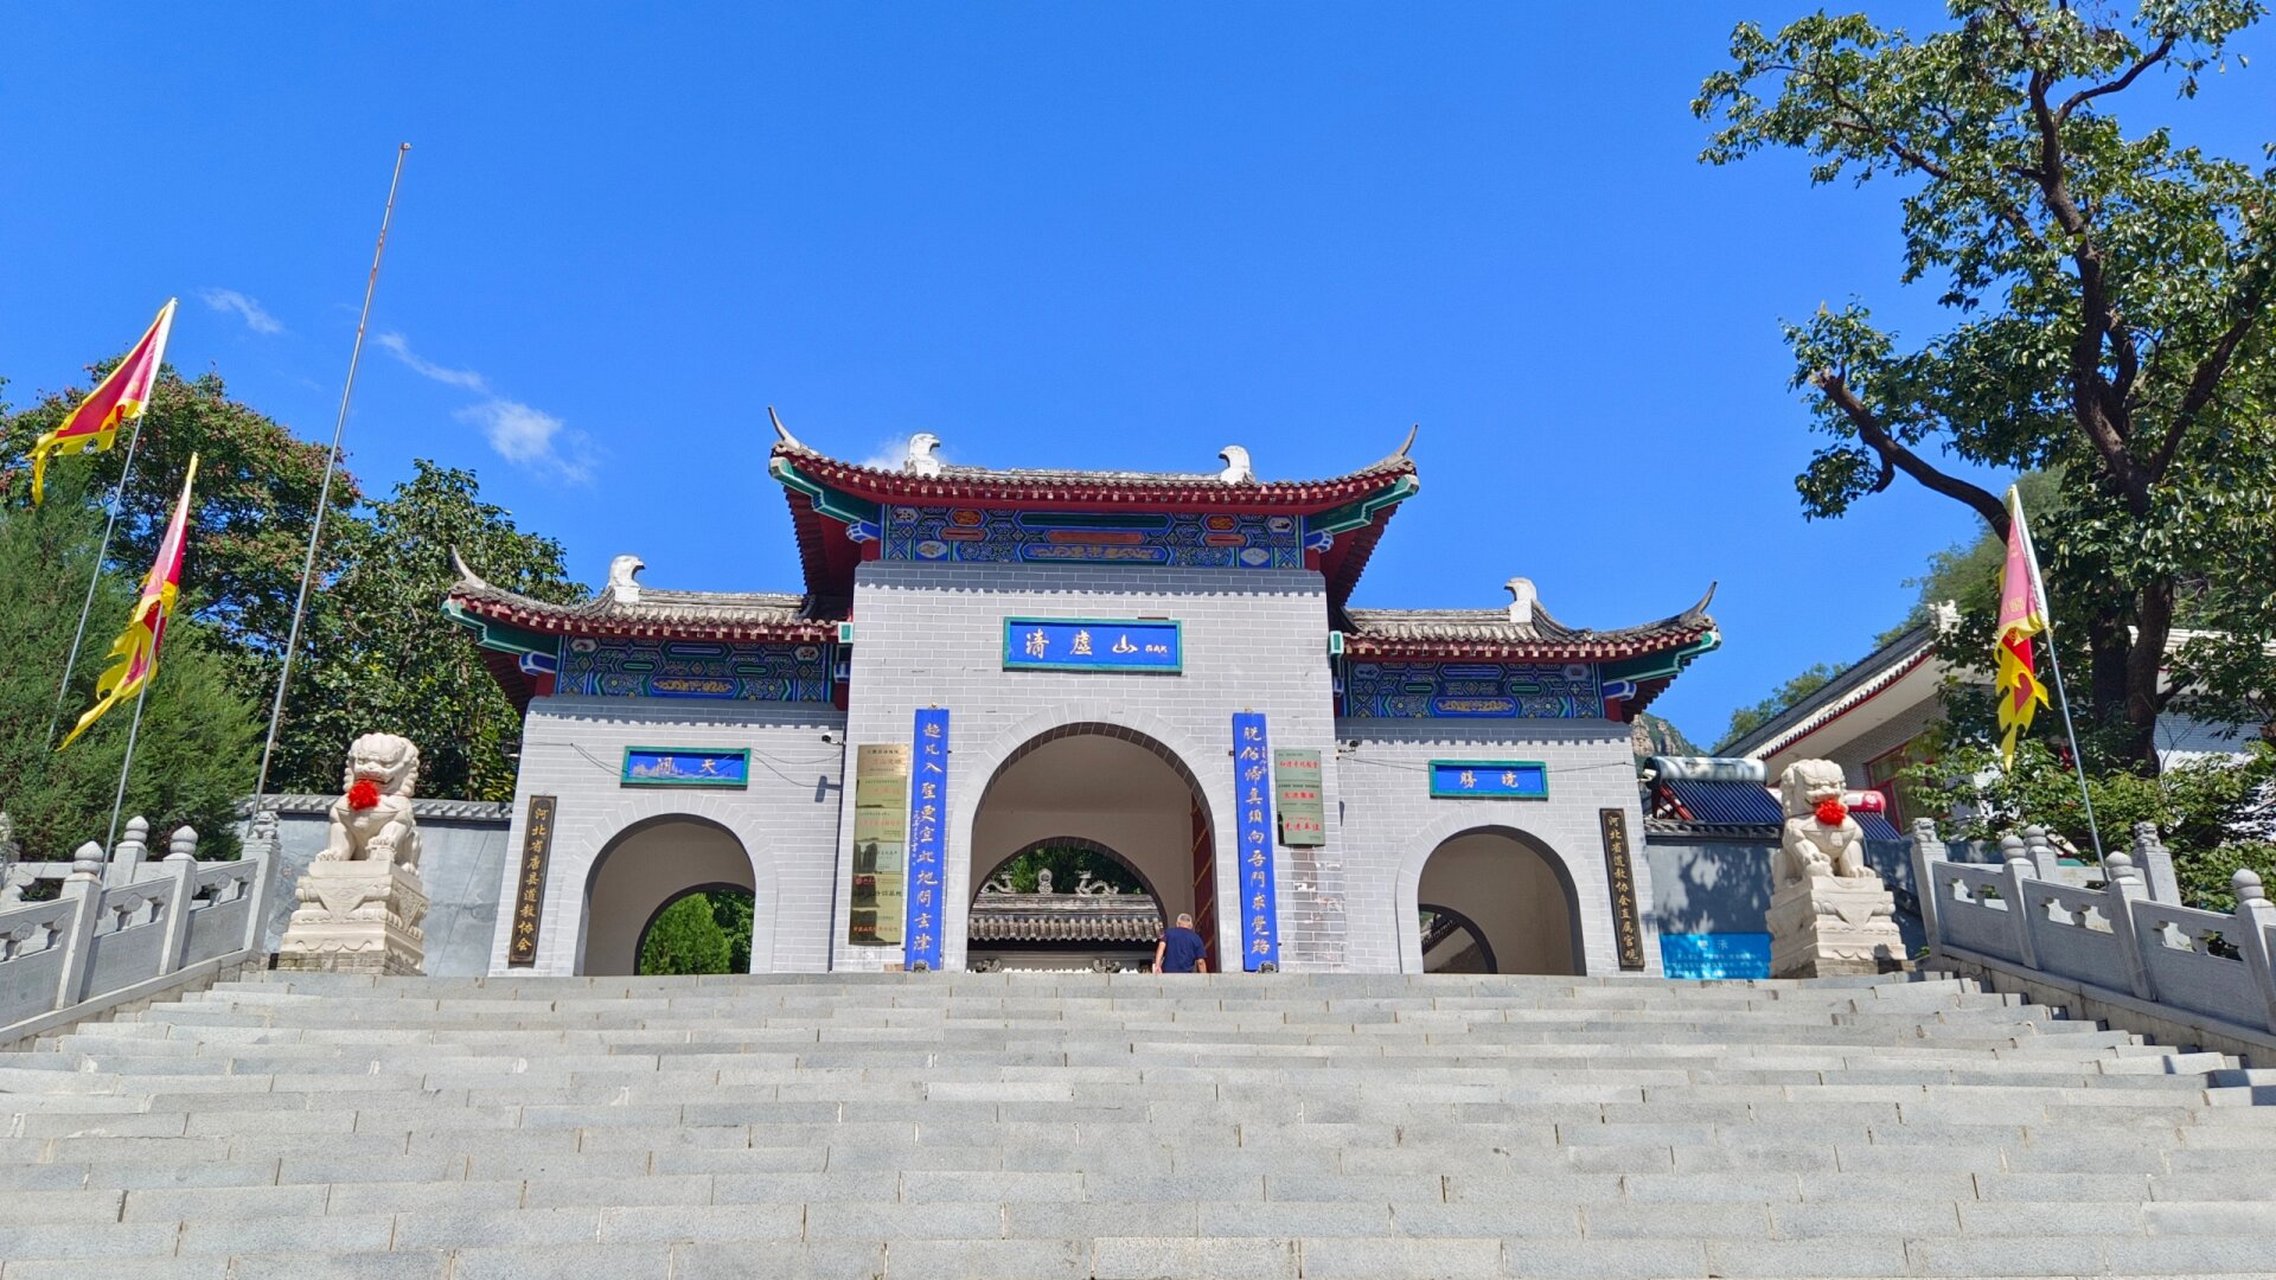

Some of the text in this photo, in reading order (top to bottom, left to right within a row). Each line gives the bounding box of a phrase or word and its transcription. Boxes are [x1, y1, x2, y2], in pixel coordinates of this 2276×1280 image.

[516, 808, 549, 952] 河北省唐县道教协会
